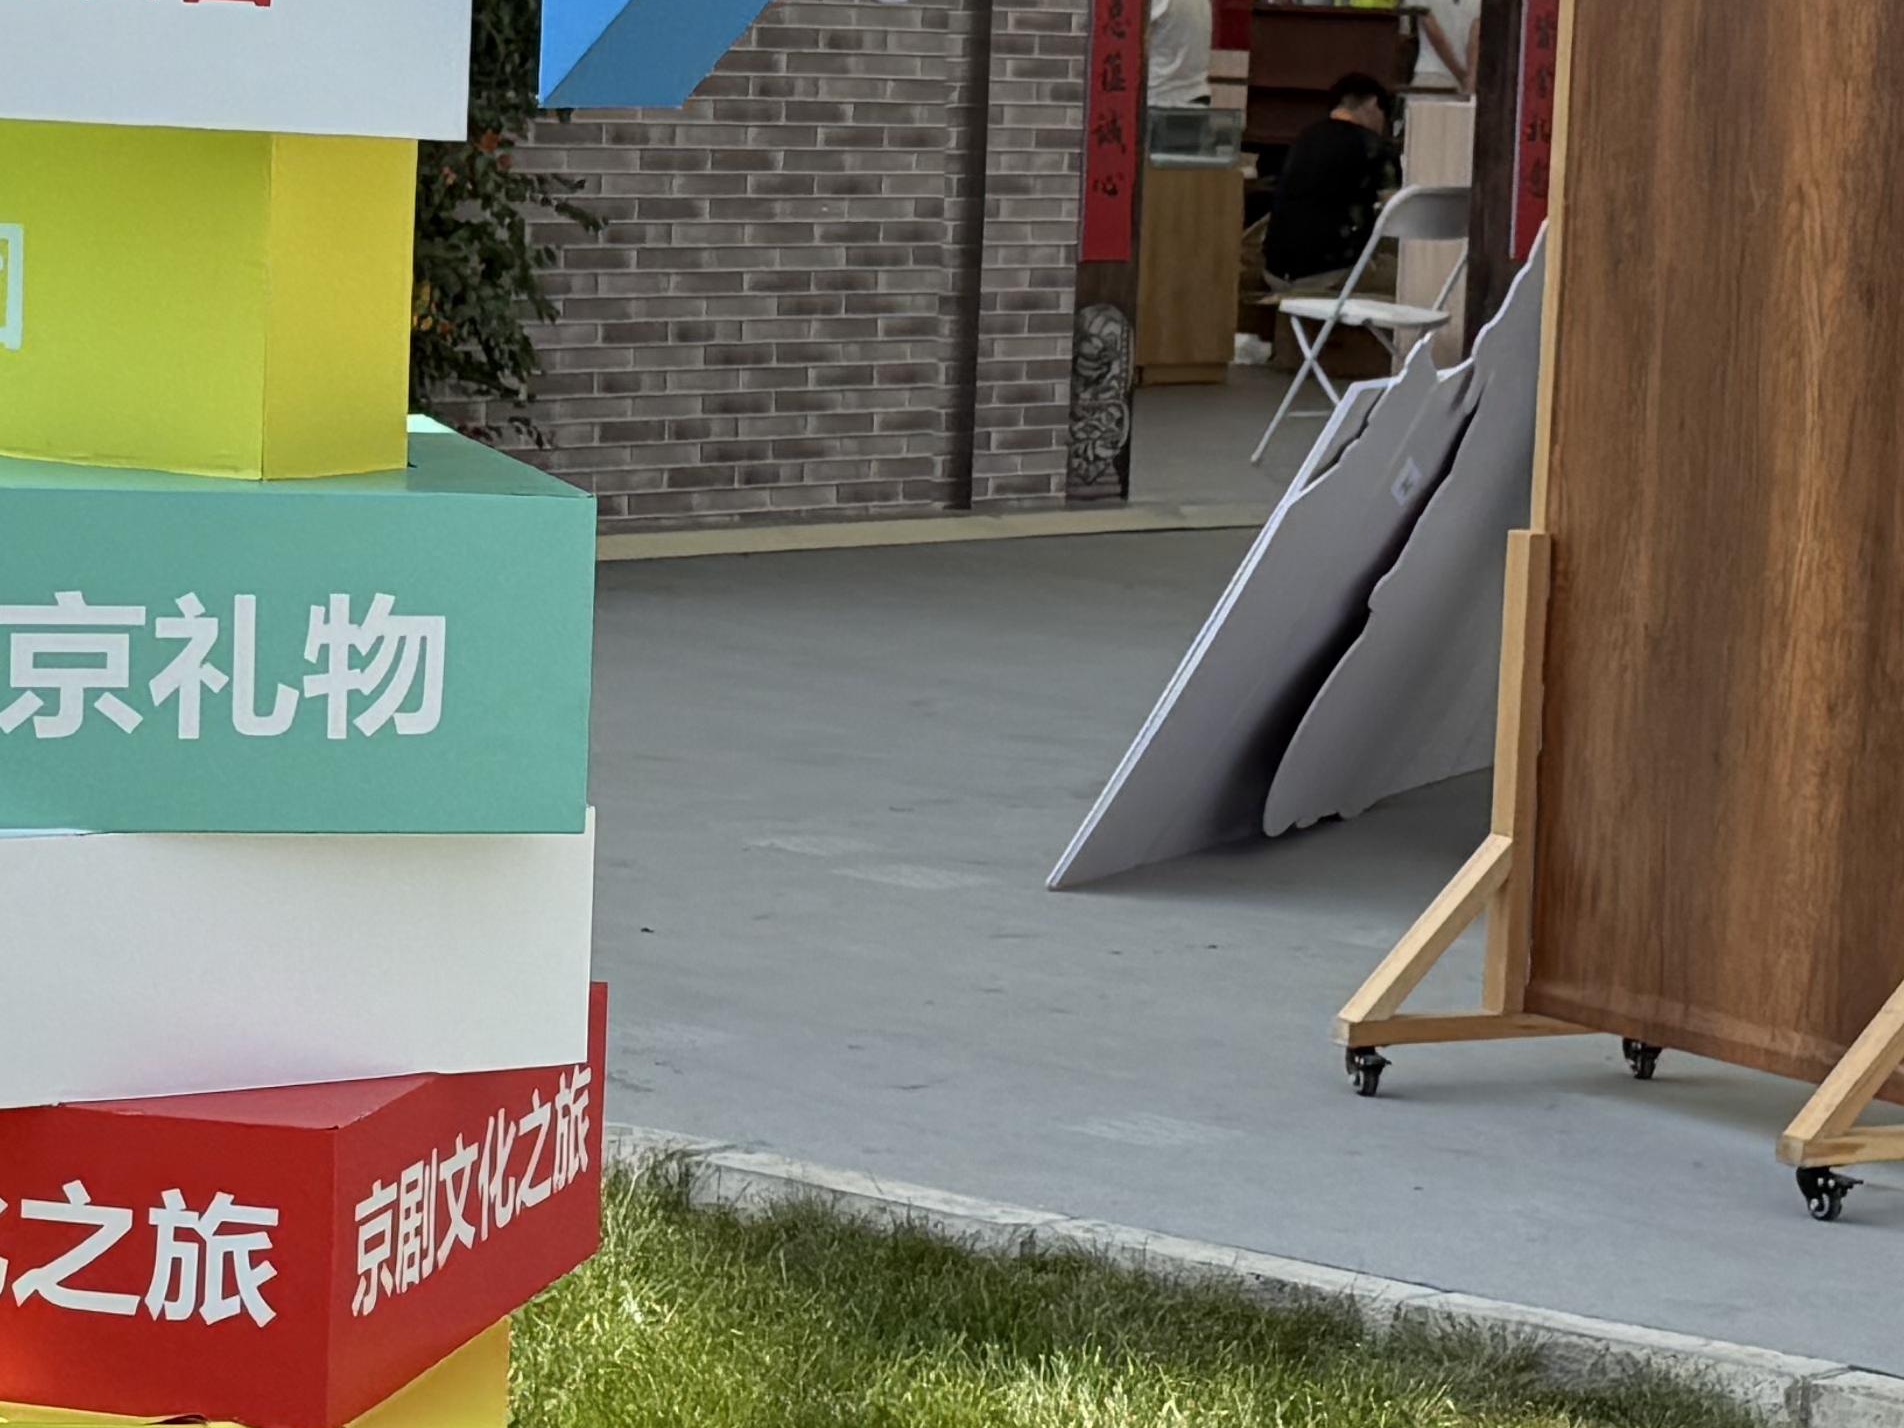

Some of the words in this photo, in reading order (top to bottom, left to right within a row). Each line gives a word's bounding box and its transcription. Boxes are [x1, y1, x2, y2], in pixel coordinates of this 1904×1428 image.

[351, 1064, 592, 1318] 京剧文化之旅
